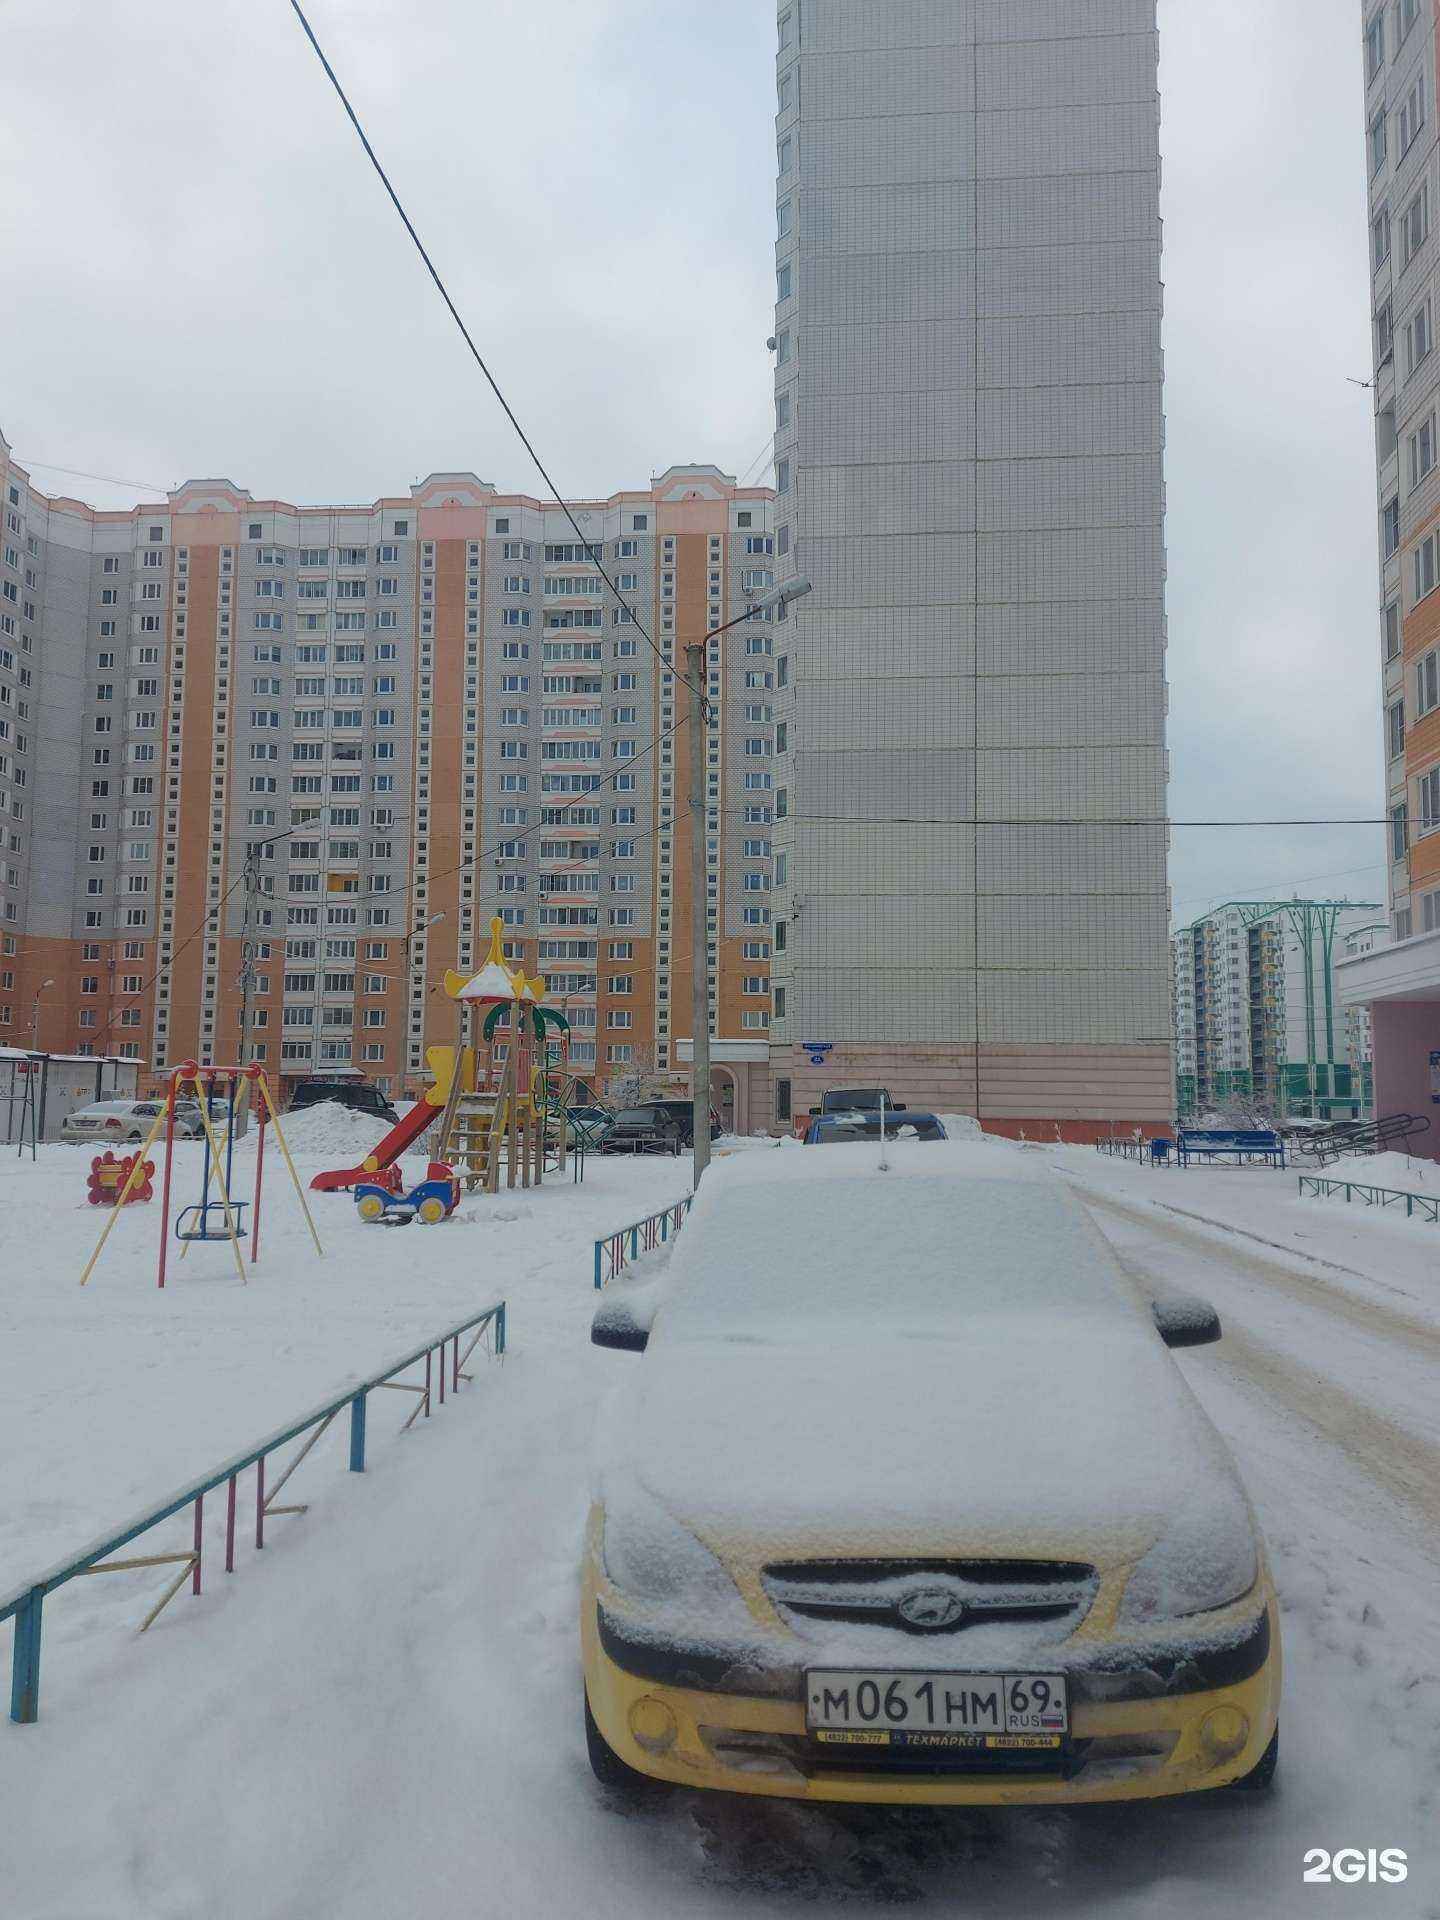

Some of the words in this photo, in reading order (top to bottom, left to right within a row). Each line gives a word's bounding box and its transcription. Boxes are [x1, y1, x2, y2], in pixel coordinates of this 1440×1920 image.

[824, 1680, 999, 1725] М061НМ
[1011, 1680, 1050, 1713] 69
[1009, 1715, 1041, 1727] RUS
[905, 1734, 983, 1747] ТЕХМАРКЕТ
